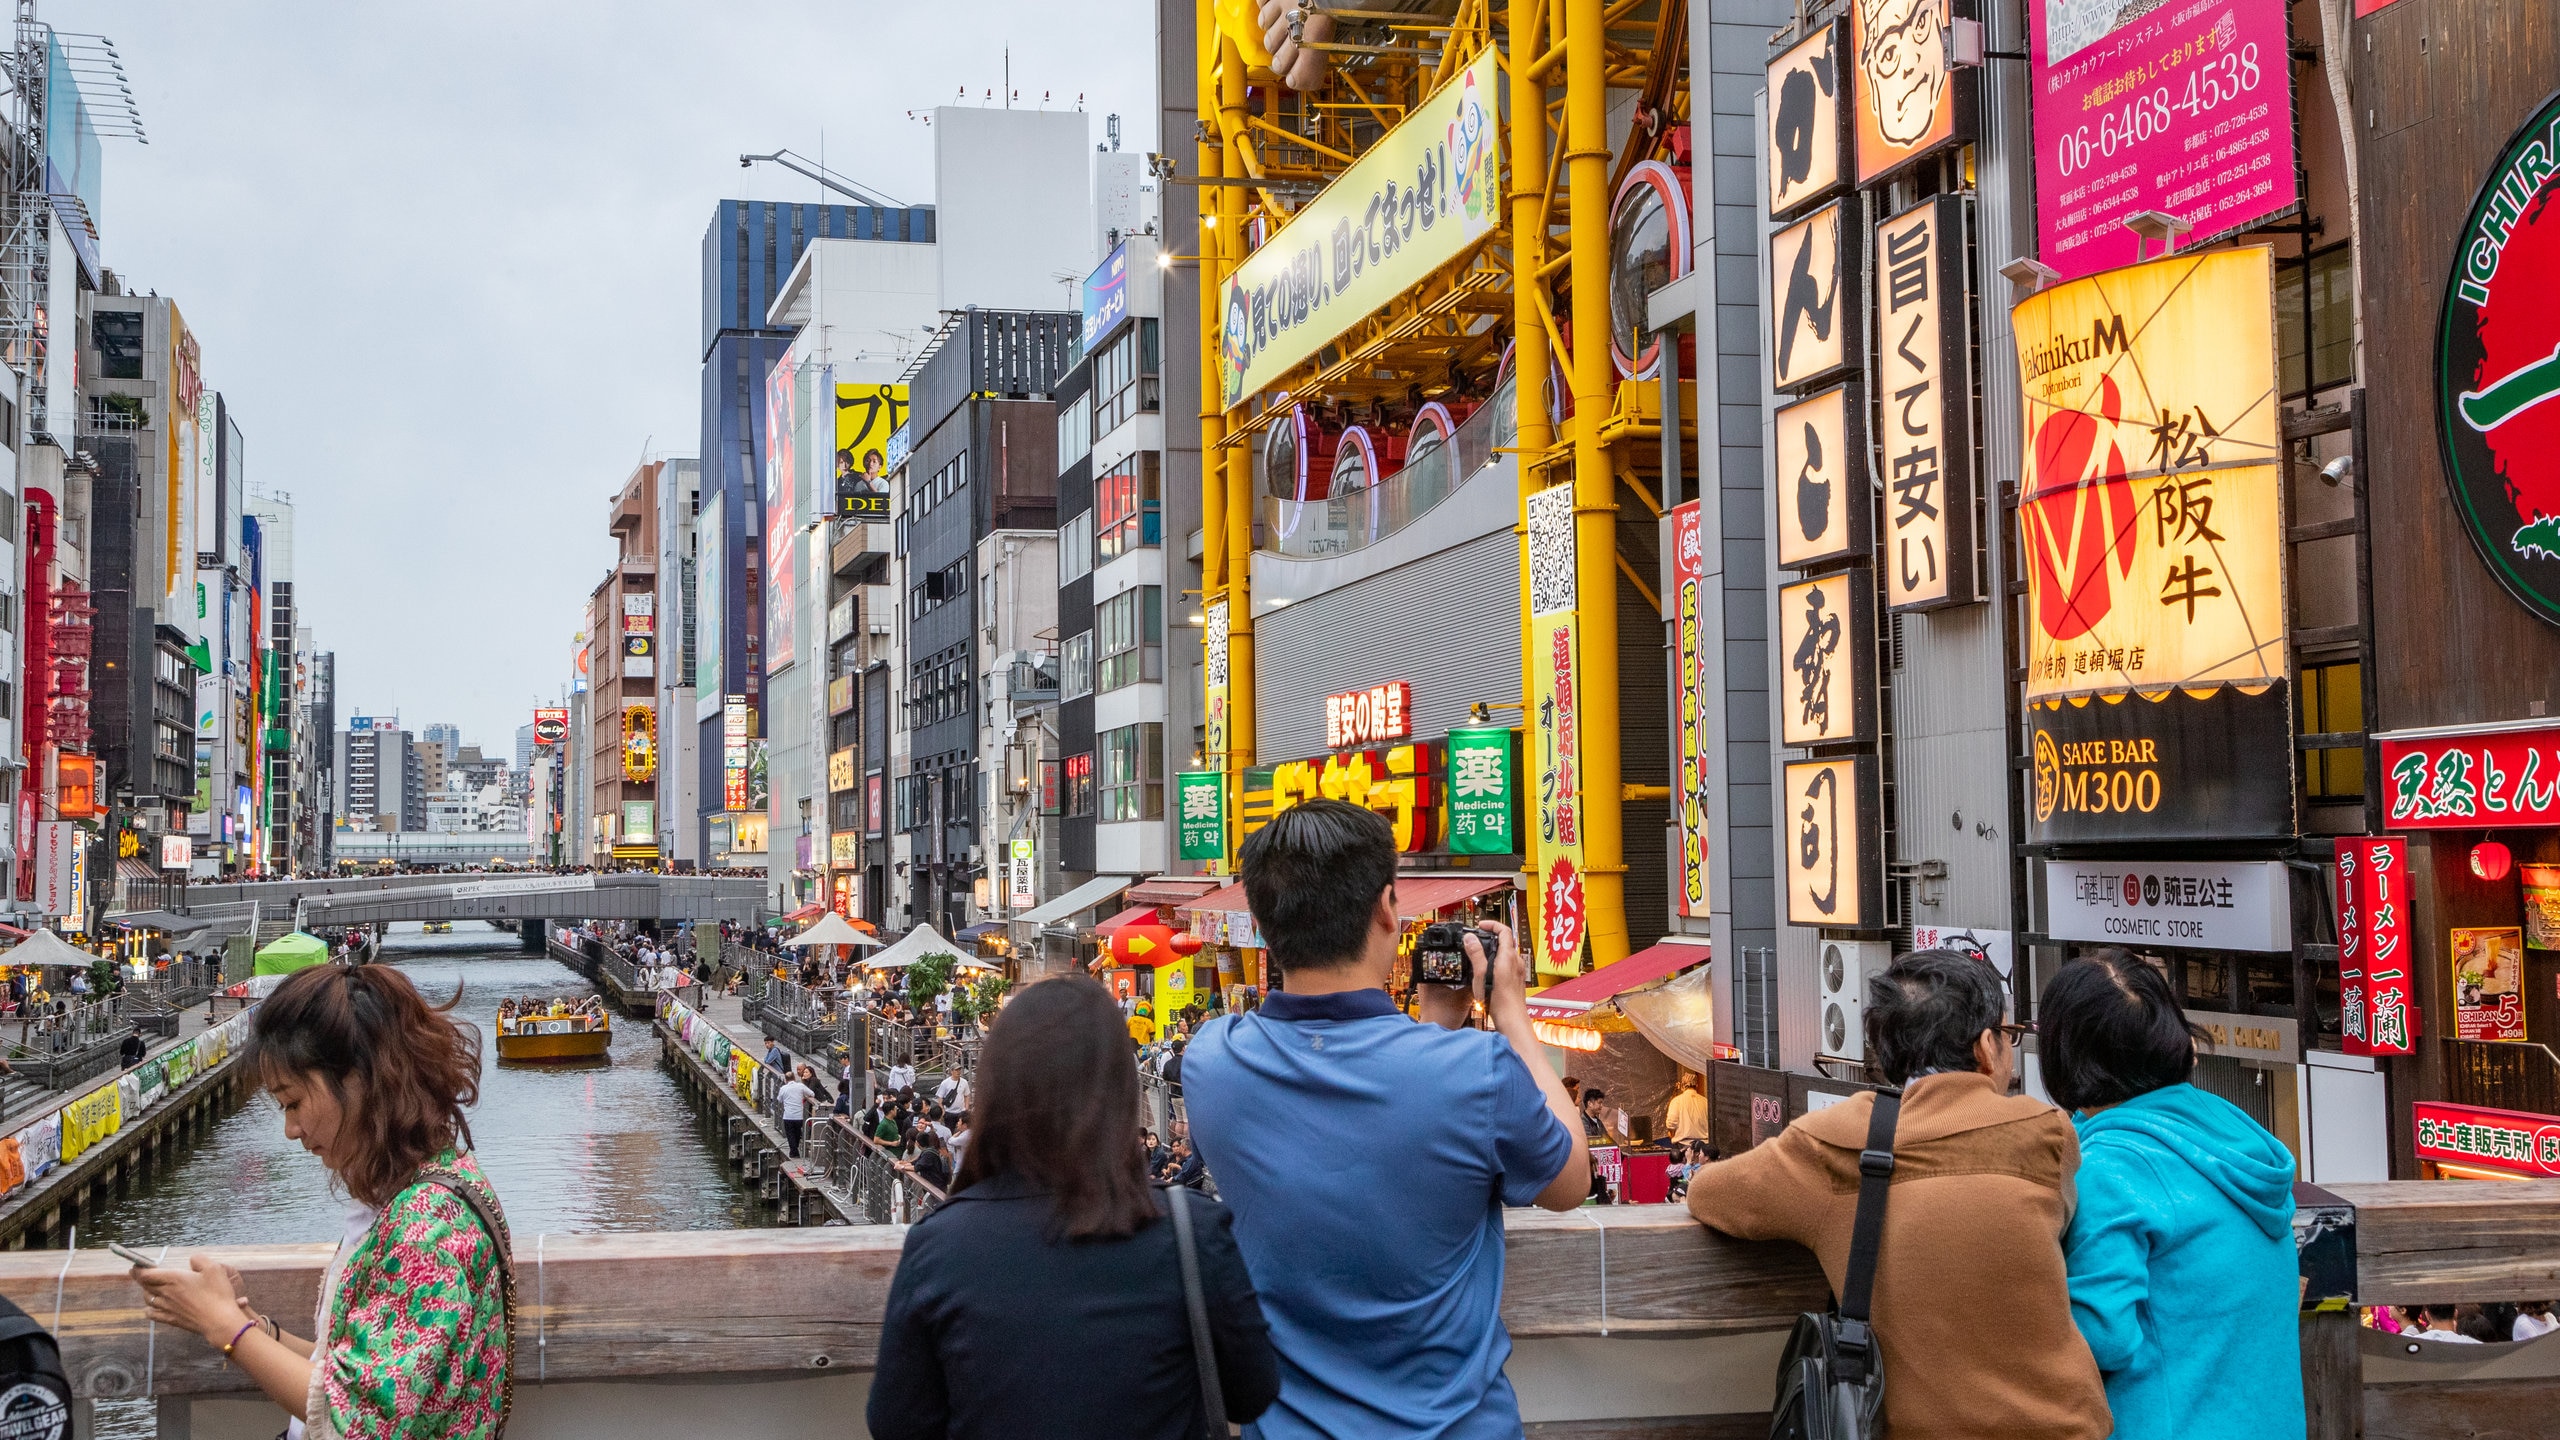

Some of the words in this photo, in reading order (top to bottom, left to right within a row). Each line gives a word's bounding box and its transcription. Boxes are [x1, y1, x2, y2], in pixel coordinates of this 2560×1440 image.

[2082, 27, 2219, 111] お電話お待ちしております
[2058, 42, 2261, 177] 06-6468-4538
[2041, 374, 2082, 398] Dotonbori
[1887, 218, 1940, 592] 旨くて安い
[845, 497, 890, 511] DE
[2146, 404, 2226, 626] 松阪牛
[2073, 646, 2146, 674] 道頓堀店
[537, 711, 566, 719] HOTEL
[1326, 681, 1403, 747] 驚安の殿堂
[1552, 625, 1577, 847] 道頓堀北館
[2063, 741, 2107, 766] SAKE
[2110, 738, 2158, 764] BAR
[1455, 746, 1504, 797] 薬
[1539, 693, 1557, 844] オープン
[2391, 747, 2560, 820] 天然とん
[1184, 784, 1218, 819] 薬
[1454, 801, 1504, 811] Medicine
[2062, 769, 2161, 813] M300
[1183, 821, 1219, 829] Medicine
[1184, 831, 1199, 847] 药
[1204, 831, 1219, 847] 약
[1456, 813, 1476, 835] 药
[1483, 813, 1504, 835] 약
[1016, 858, 1028, 894] 瓦屋薬粧
[1551, 873, 1577, 912] すぐ
[2163, 876, 2234, 908] 豌豆公主
[1552, 917, 1575, 951] そこ
[1916, 927, 1938, 950] 熊野
[2105, 917, 2161, 936] COSMETIC
[2167, 920, 2203, 938] STORE
[2459, 1011, 2498, 1022] ICHIRAN
[2234, 1026, 2281, 1050] KAIKAN
[2418, 1118, 2532, 1163] お土産販売所
[34, 1407, 68, 1430] GEAR
